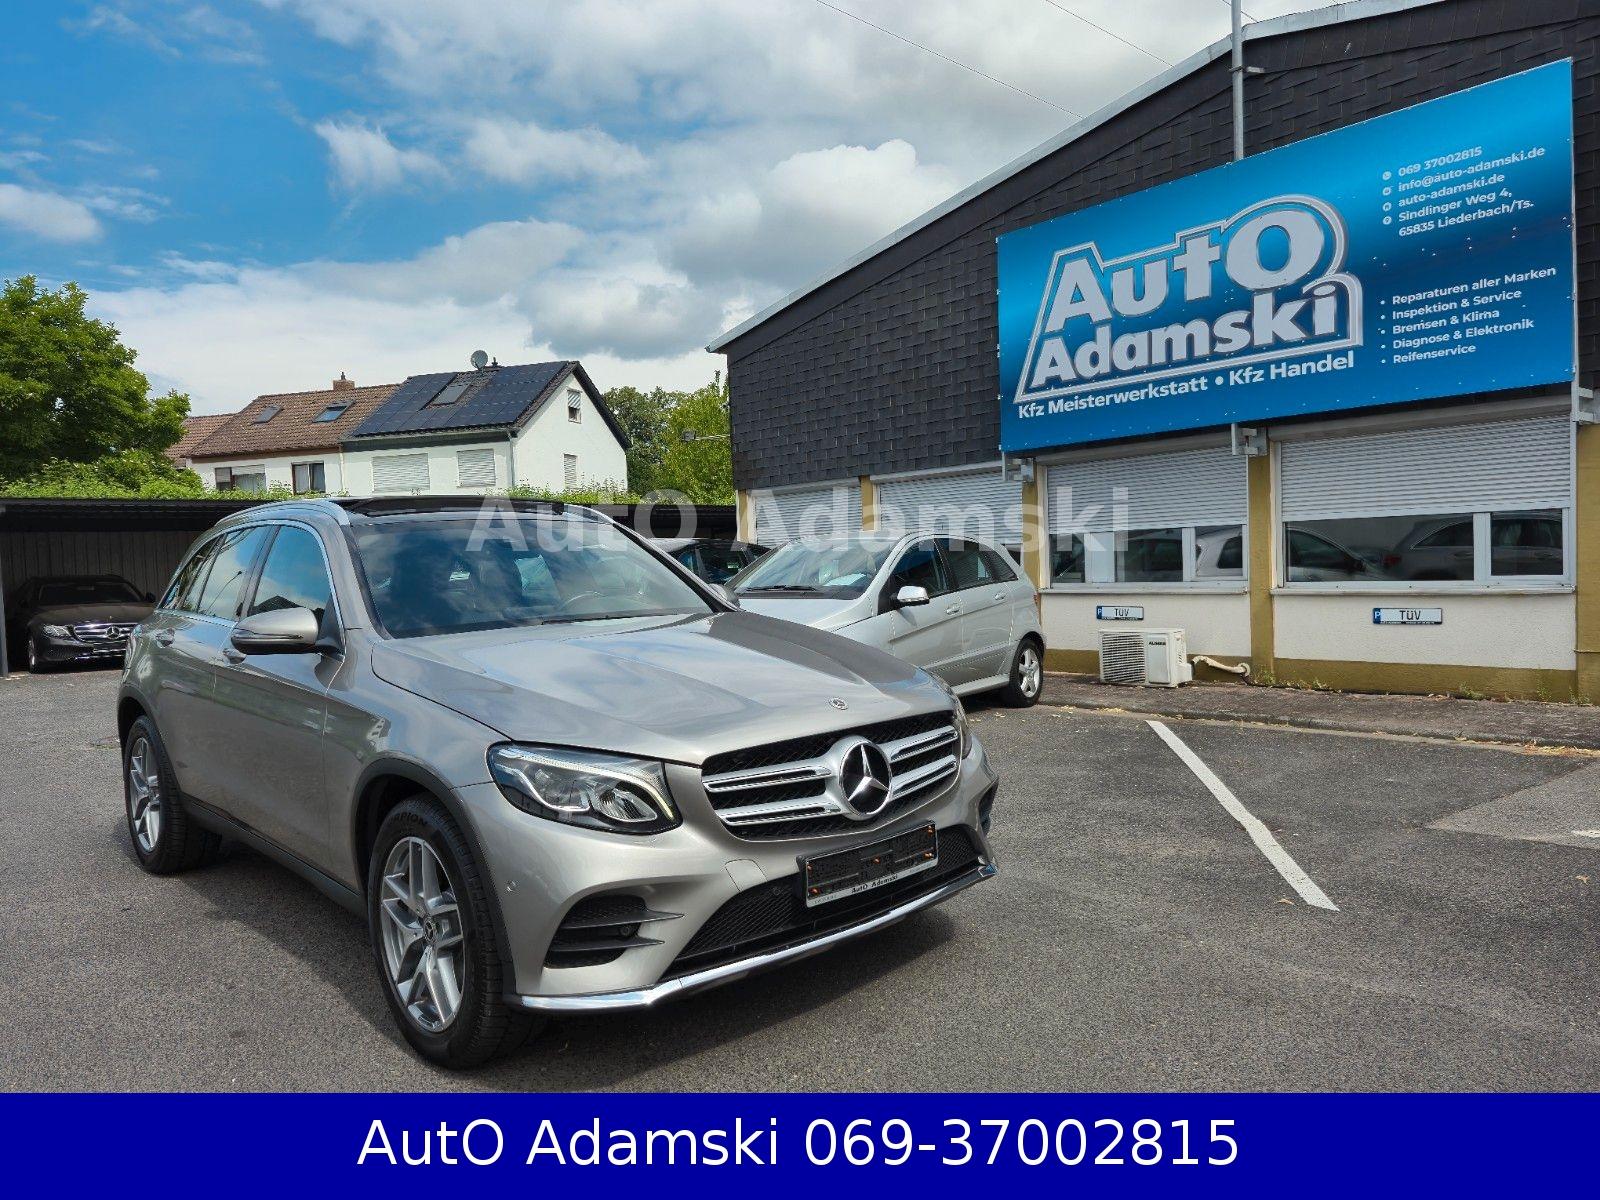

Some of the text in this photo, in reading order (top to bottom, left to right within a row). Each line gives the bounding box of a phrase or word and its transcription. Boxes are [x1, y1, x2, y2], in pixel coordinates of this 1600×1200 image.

[1398, 146, 1483, 177] 069 37002815
[1398, 146, 1546, 192] info@auto-adamski.de
[1398, 173, 1506, 207] auto-adamski.de
[1398, 187, 1513, 222] Sindlinger Weg 4,
[1398, 199, 1535, 237] 65835 Liederbach/Ts.
[1044, 210, 1325, 333] AutO
[1392, 266, 1557, 306] Reparaturen aller Marken
[1392, 289, 1522, 320] Inspektion & Service
[1030, 284, 1338, 389] Adamski
[1392, 309, 1500, 335] Bremsen & Klima
[1392, 318, 1535, 350] Diagnose & Elektronik
[1393, 344, 1477, 364] Reifenservice
[1018, 350, 1354, 419] Kfz Meisterwerkstatt Kfz Handel
[1374, 611, 1381, 620] P
